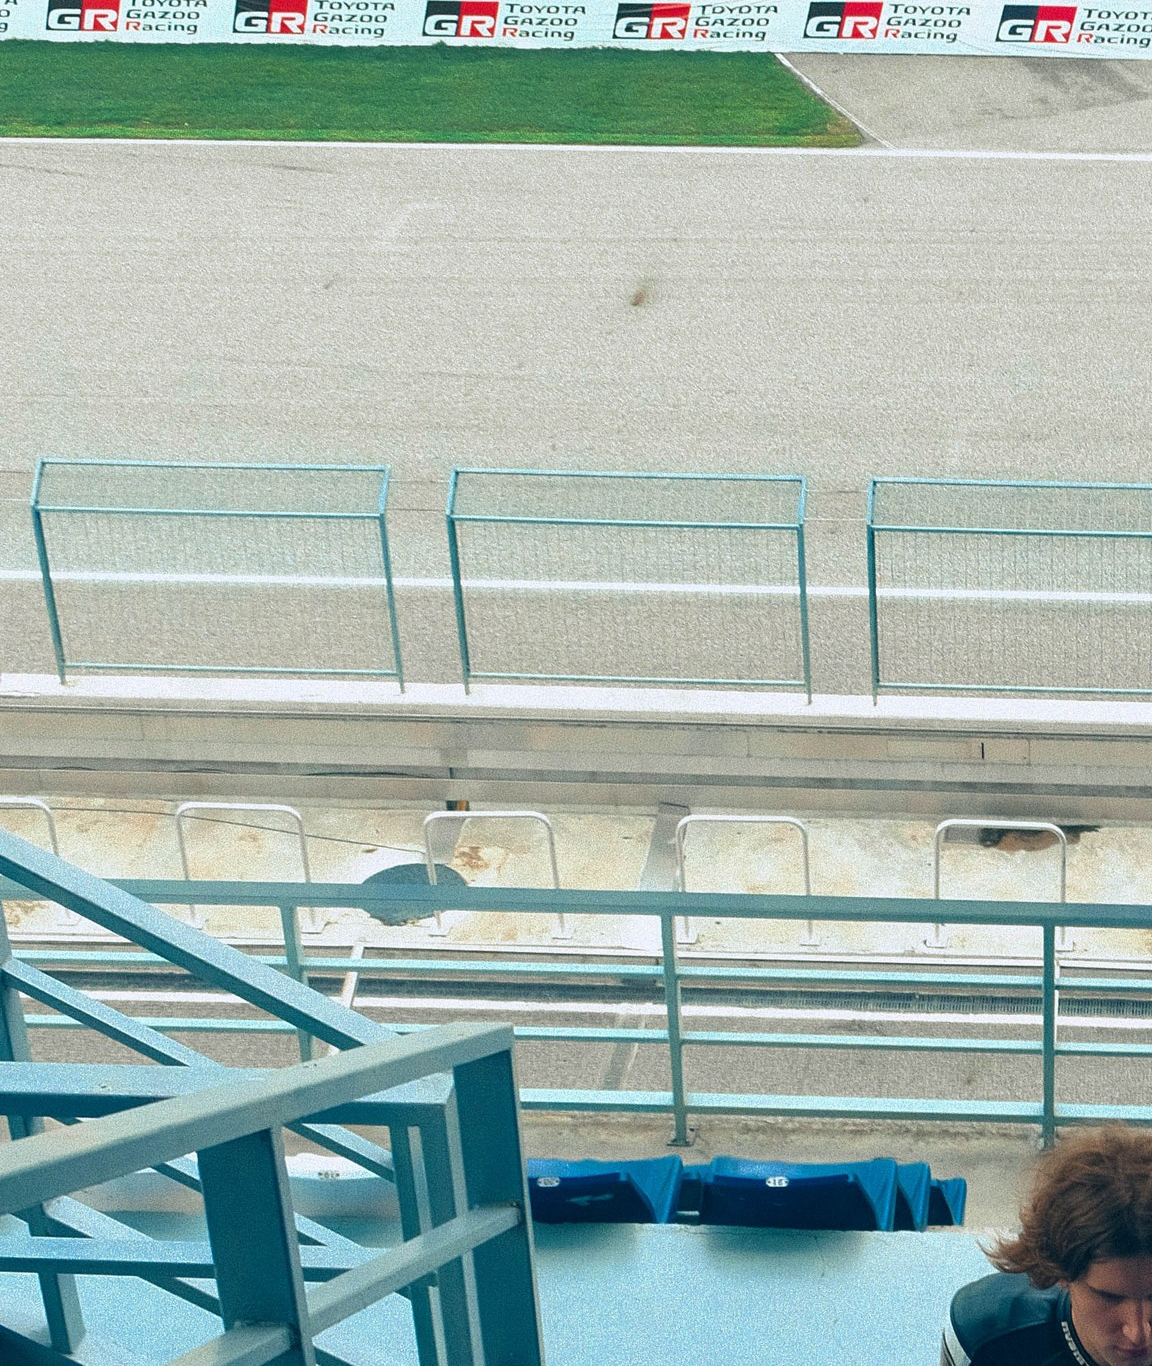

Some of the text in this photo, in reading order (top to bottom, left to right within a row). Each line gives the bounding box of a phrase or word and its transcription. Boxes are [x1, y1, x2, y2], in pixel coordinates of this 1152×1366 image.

[315, 0, 395, 11] TOYOTA
[505, 3, 586, 15] TOYOTA
[697, 3, 778, 15] TOYOTA
[889, 3, 970, 16] TOYOTA
[48, 8, 117, 31] GR
[126, 9, 200, 20] GAZOO
[313, 12, 388, 23] GAZOO
[504, 15, 578, 27] GAZOO
[695, 16, 769, 27] GAZOO
[126, 21, 199, 35] Racing
[235, 11, 305, 34] GR
[424, 14, 496, 37] GR
[614, 16, 689, 39] GR
[805, 16, 879, 39] GR
[886, 16, 961, 28] GAZOO
[312, 24, 385, 38] Racing
[502, 27, 575, 41] Racing
[693, 28, 766, 42] Racing
[885, 29, 958, 43] Racing
[997, 19, 1073, 43] GR
[1077, 34, 1151, 48] Racing
